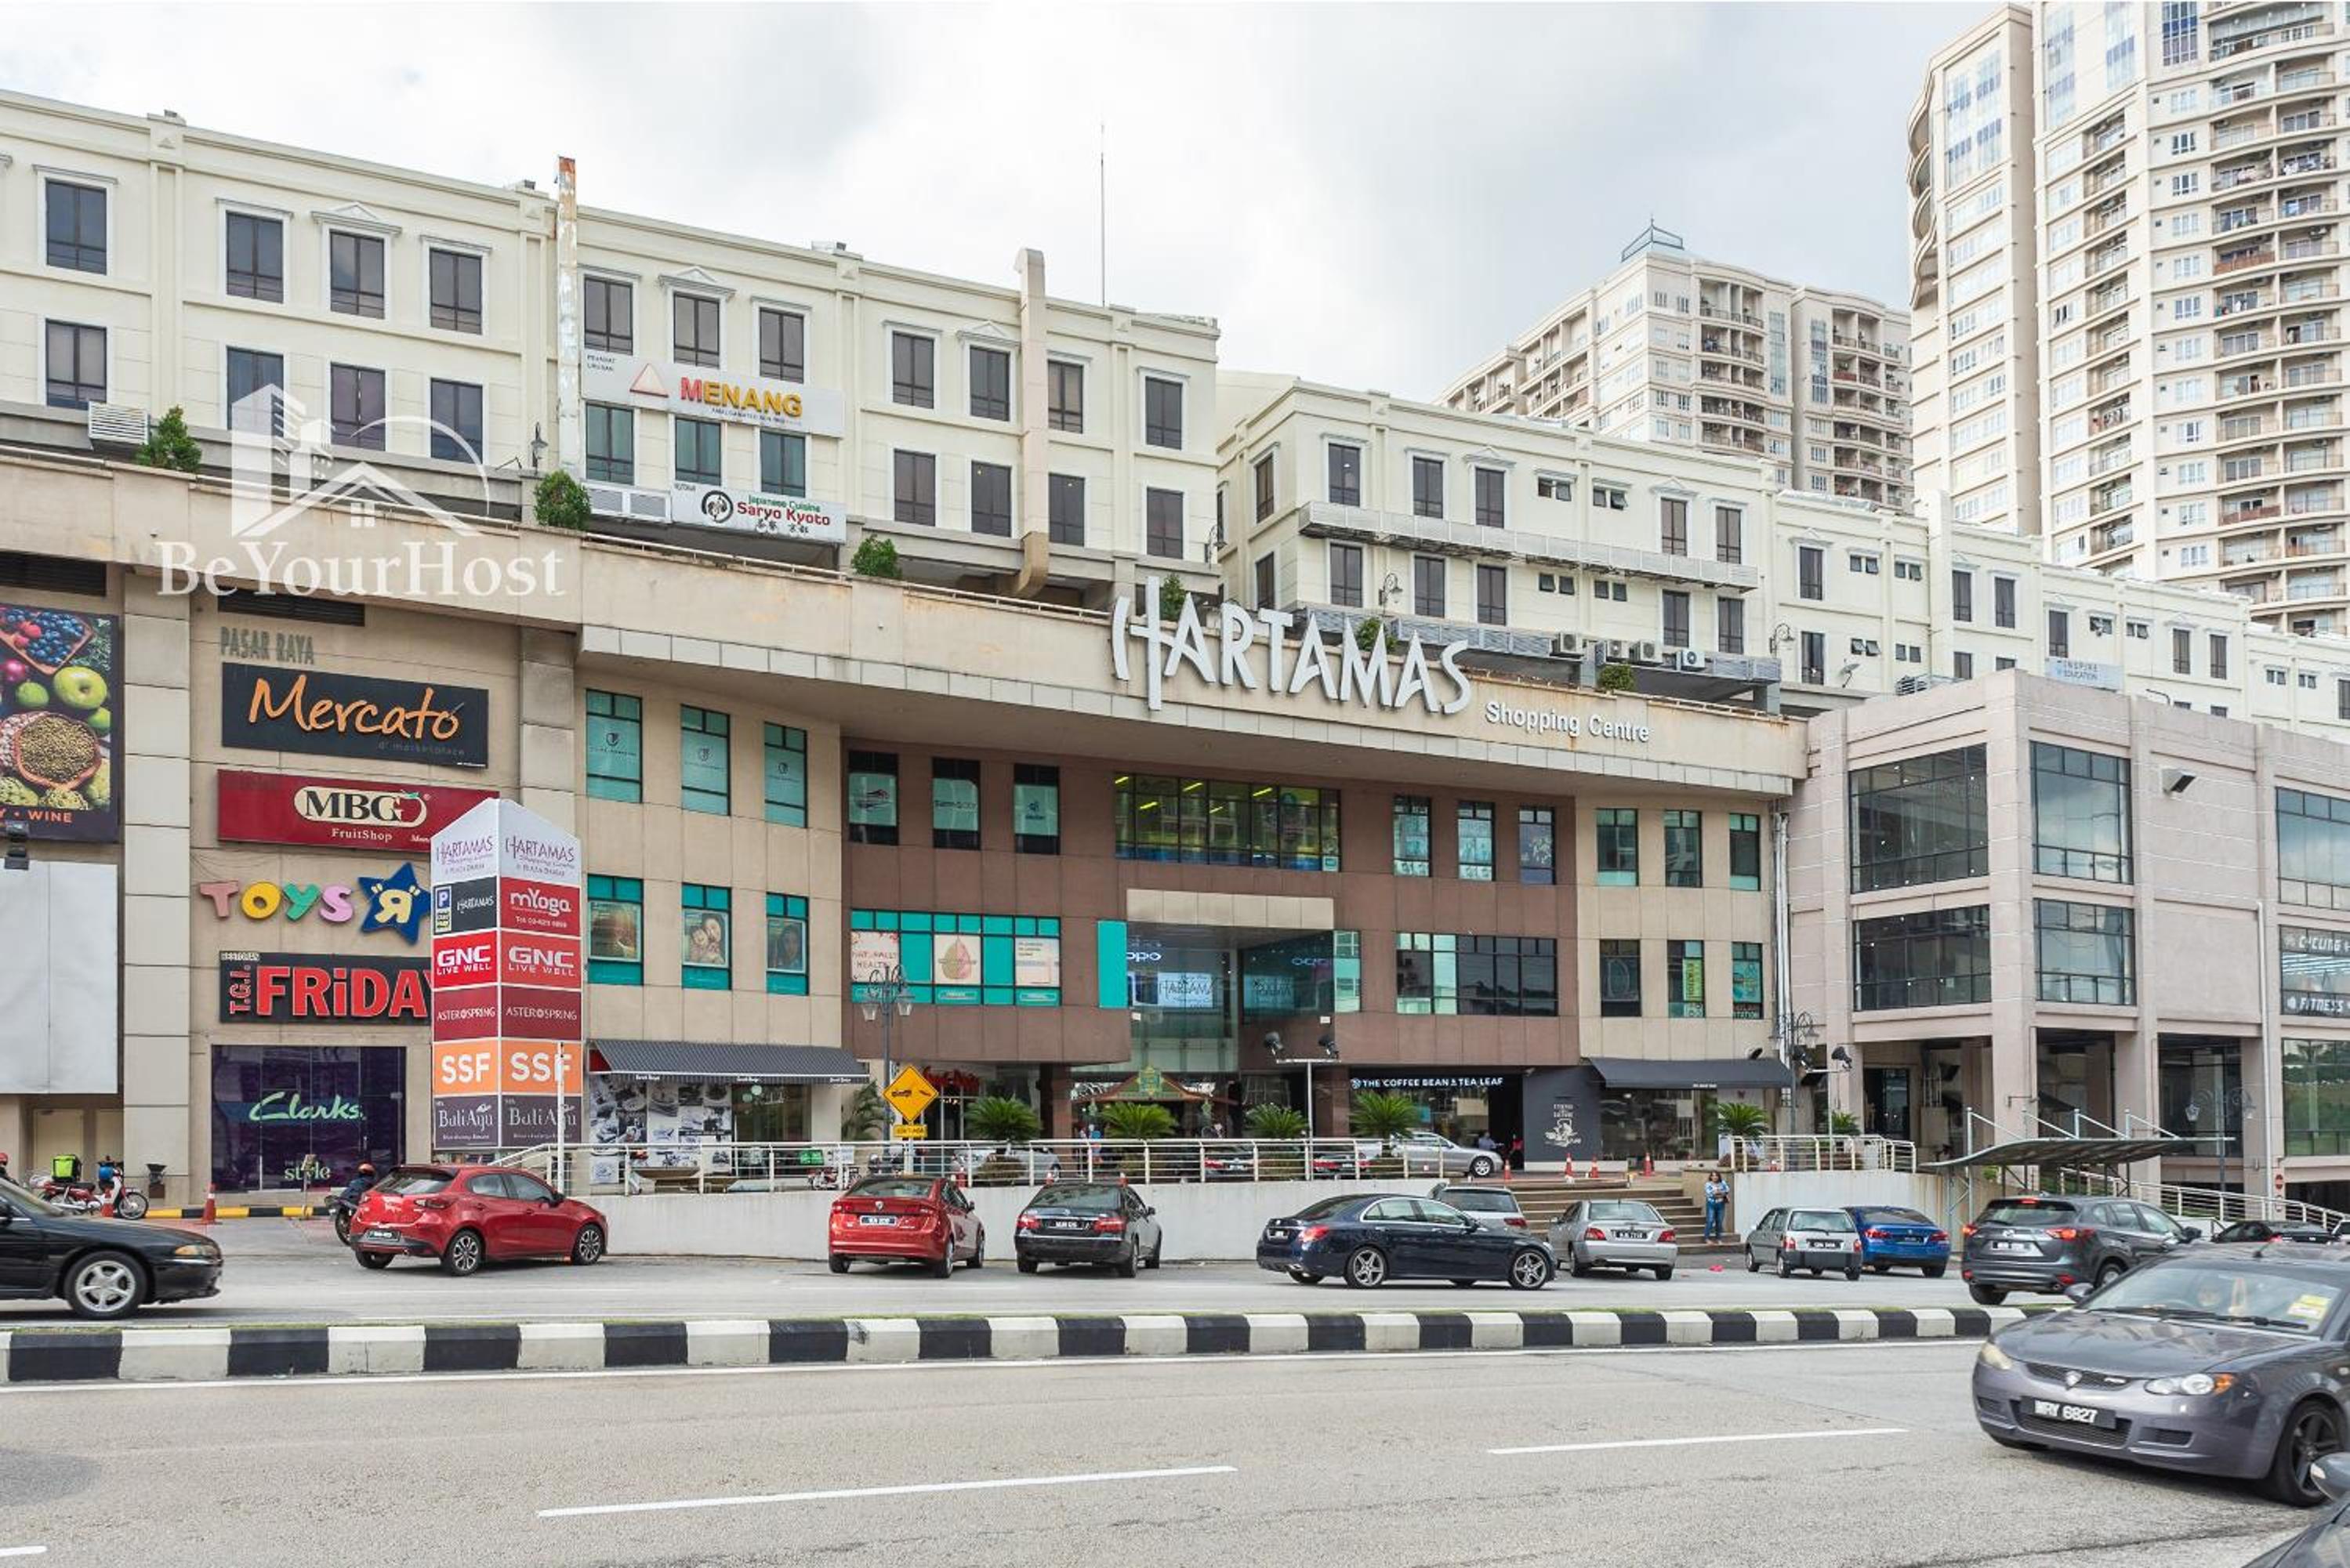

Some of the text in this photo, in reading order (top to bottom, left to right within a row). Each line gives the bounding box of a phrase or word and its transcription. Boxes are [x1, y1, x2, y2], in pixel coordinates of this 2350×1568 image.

[680, 376, 803, 418] MENANG
[738, 502, 830, 525] Saryo Kyoto
[749, 495, 821, 512] Japanese Cuisine
[220, 627, 314, 664] PASAR RAYA
[1112, 576, 1472, 715] HARTAMAS
[248, 674, 459, 739] Mercato
[1486, 701, 1649, 742] Shopping Centre
[28, 809, 72, 823] WINE
[306, 790, 401, 821] MBG
[332, 828, 392, 842] FruitShop
[506, 835, 575, 862] HARTAMAS
[200, 881, 354, 922] TOYS
[439, 892, 448, 907] P
[510, 888, 571, 917] mYoga
[437, 945, 491, 968] GNC
[437, 964, 491, 976] LIVE WELL
[509, 947, 574, 968] GNC
[509, 964, 575, 976] LIVE WELL
[256, 966, 431, 1017] FRiDA
[441, 1053, 491, 1085] SSF
[510, 1052, 571, 1081] SSF
[1422, 1078, 1449, 1087] BEAN
